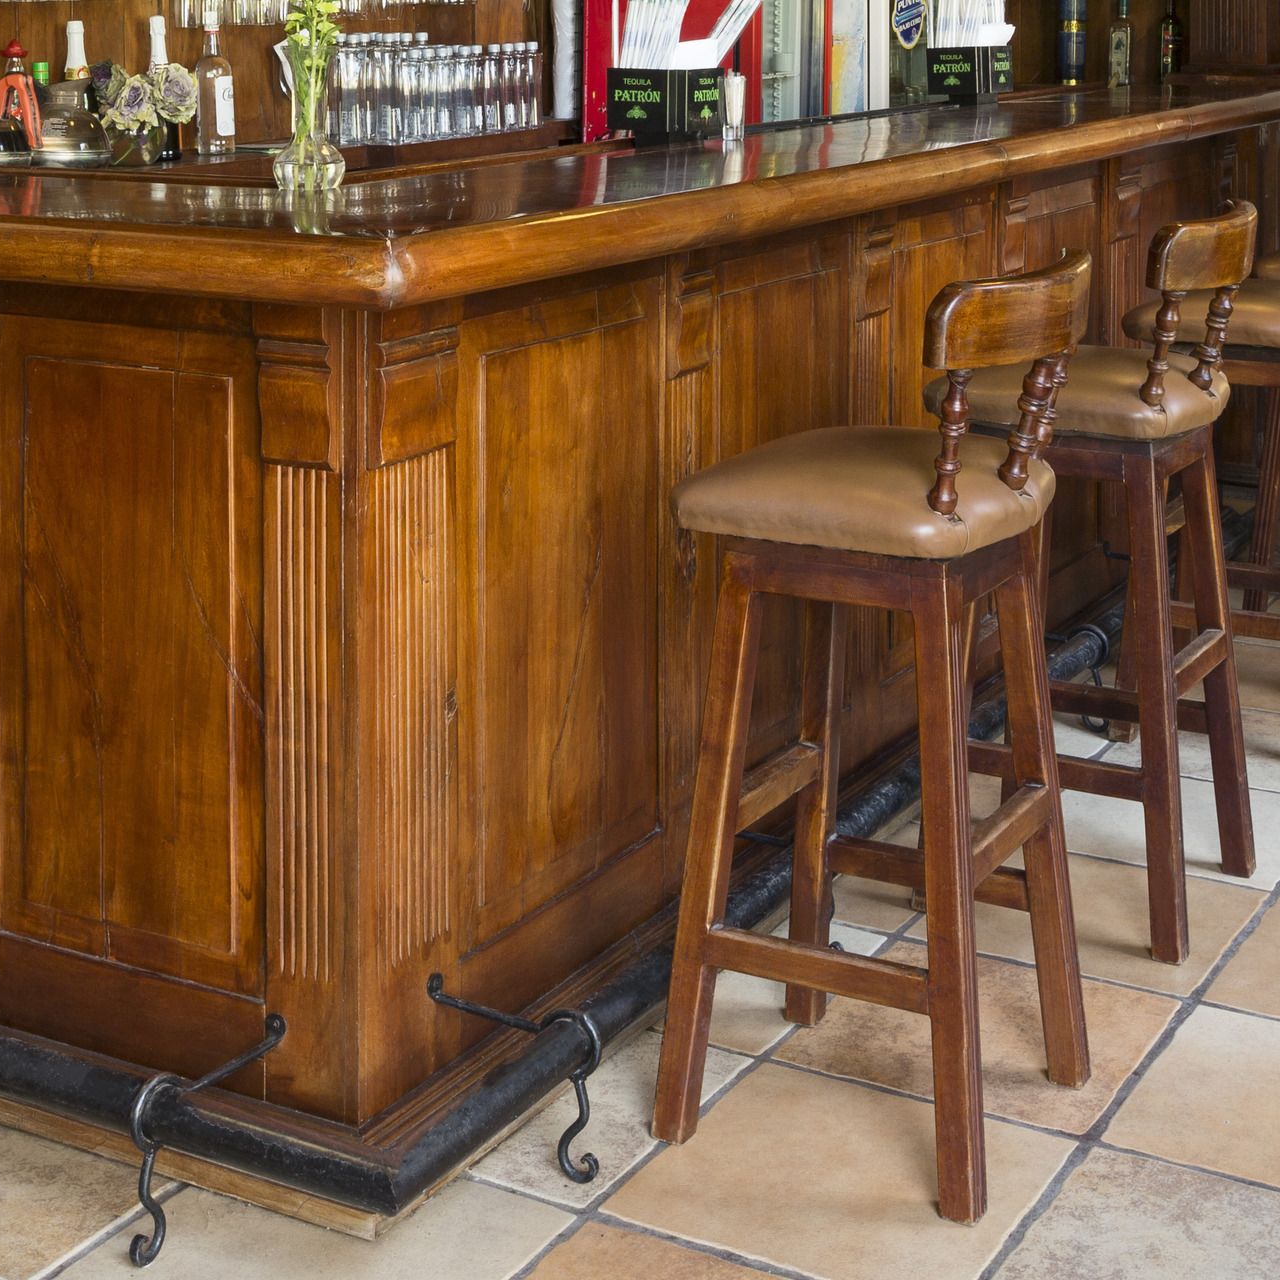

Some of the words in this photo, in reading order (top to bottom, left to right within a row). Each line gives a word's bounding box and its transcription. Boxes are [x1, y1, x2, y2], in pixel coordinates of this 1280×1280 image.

[933, 61, 971, 74] PATRÓN
[993, 60, 1010, 72] PATRÓN
[623, 77, 652, 86] TEQUILA
[699, 77, 714, 85] TEQUILA
[614, 88, 661, 103] PATRÓN
[694, 87, 720, 103] PATRÓN
